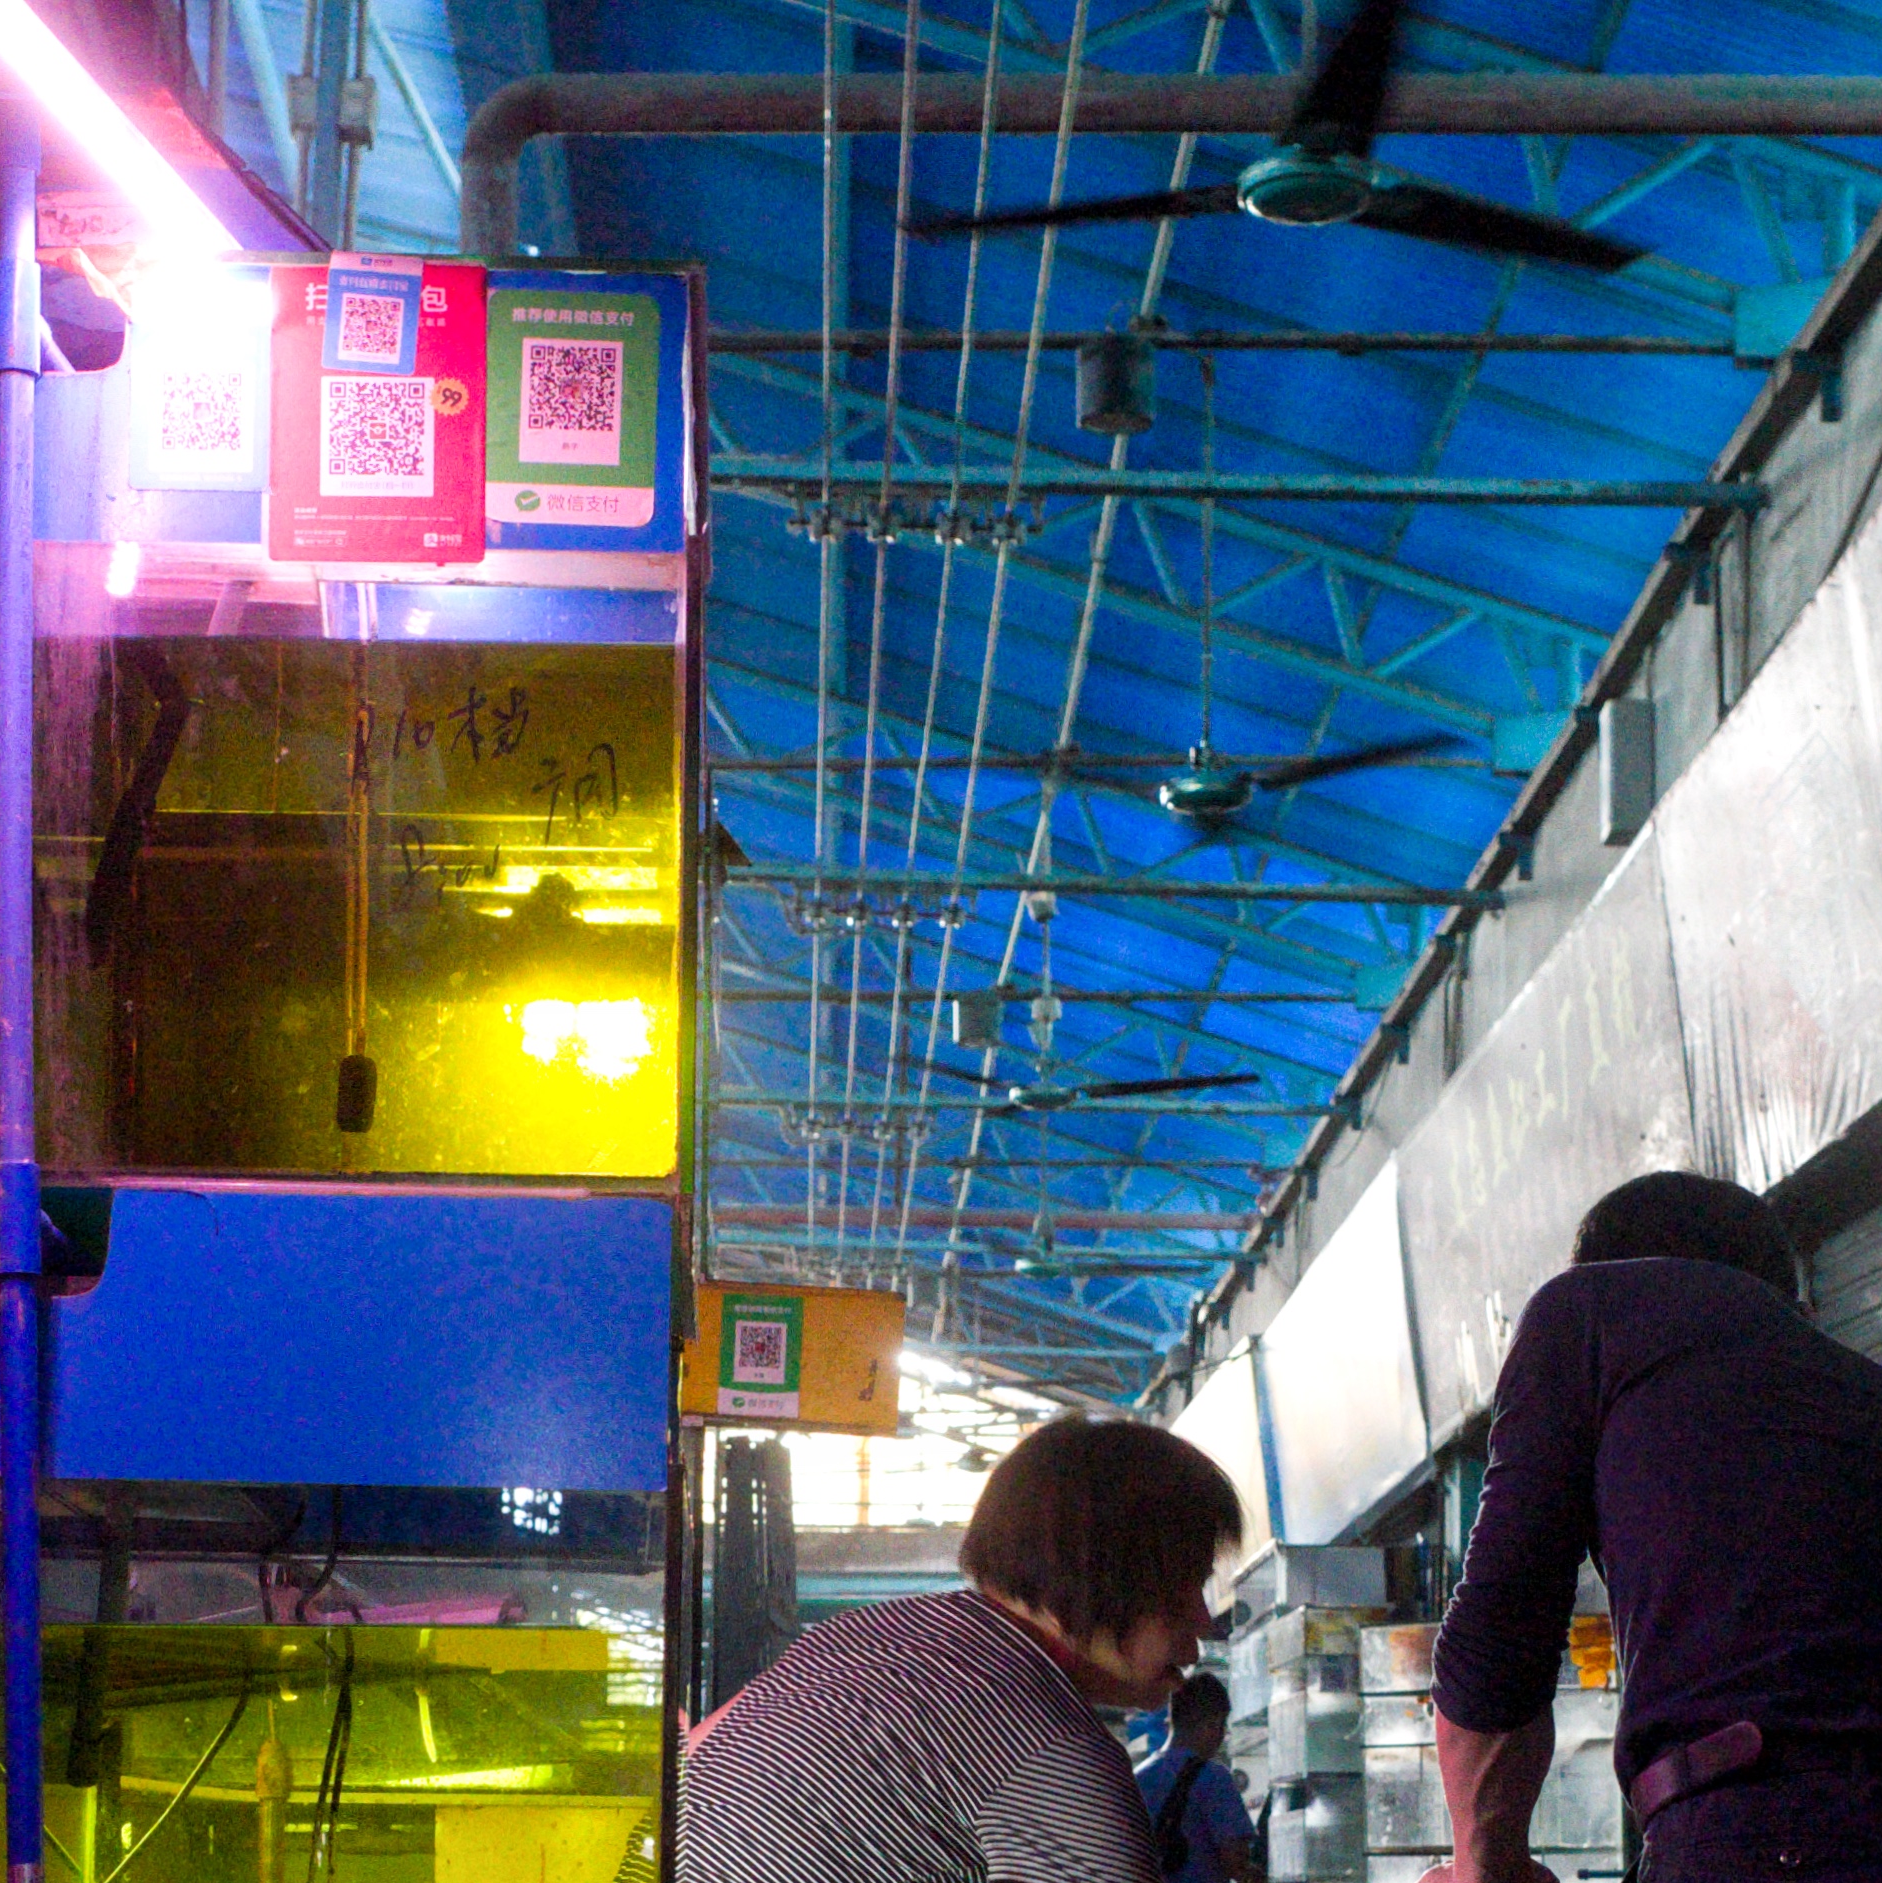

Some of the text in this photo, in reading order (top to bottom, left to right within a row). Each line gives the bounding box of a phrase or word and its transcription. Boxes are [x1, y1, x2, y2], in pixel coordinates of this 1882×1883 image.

[512, 307, 635, 327] 推荐使用微信支付
[547, 493, 619, 514] 微信支付
